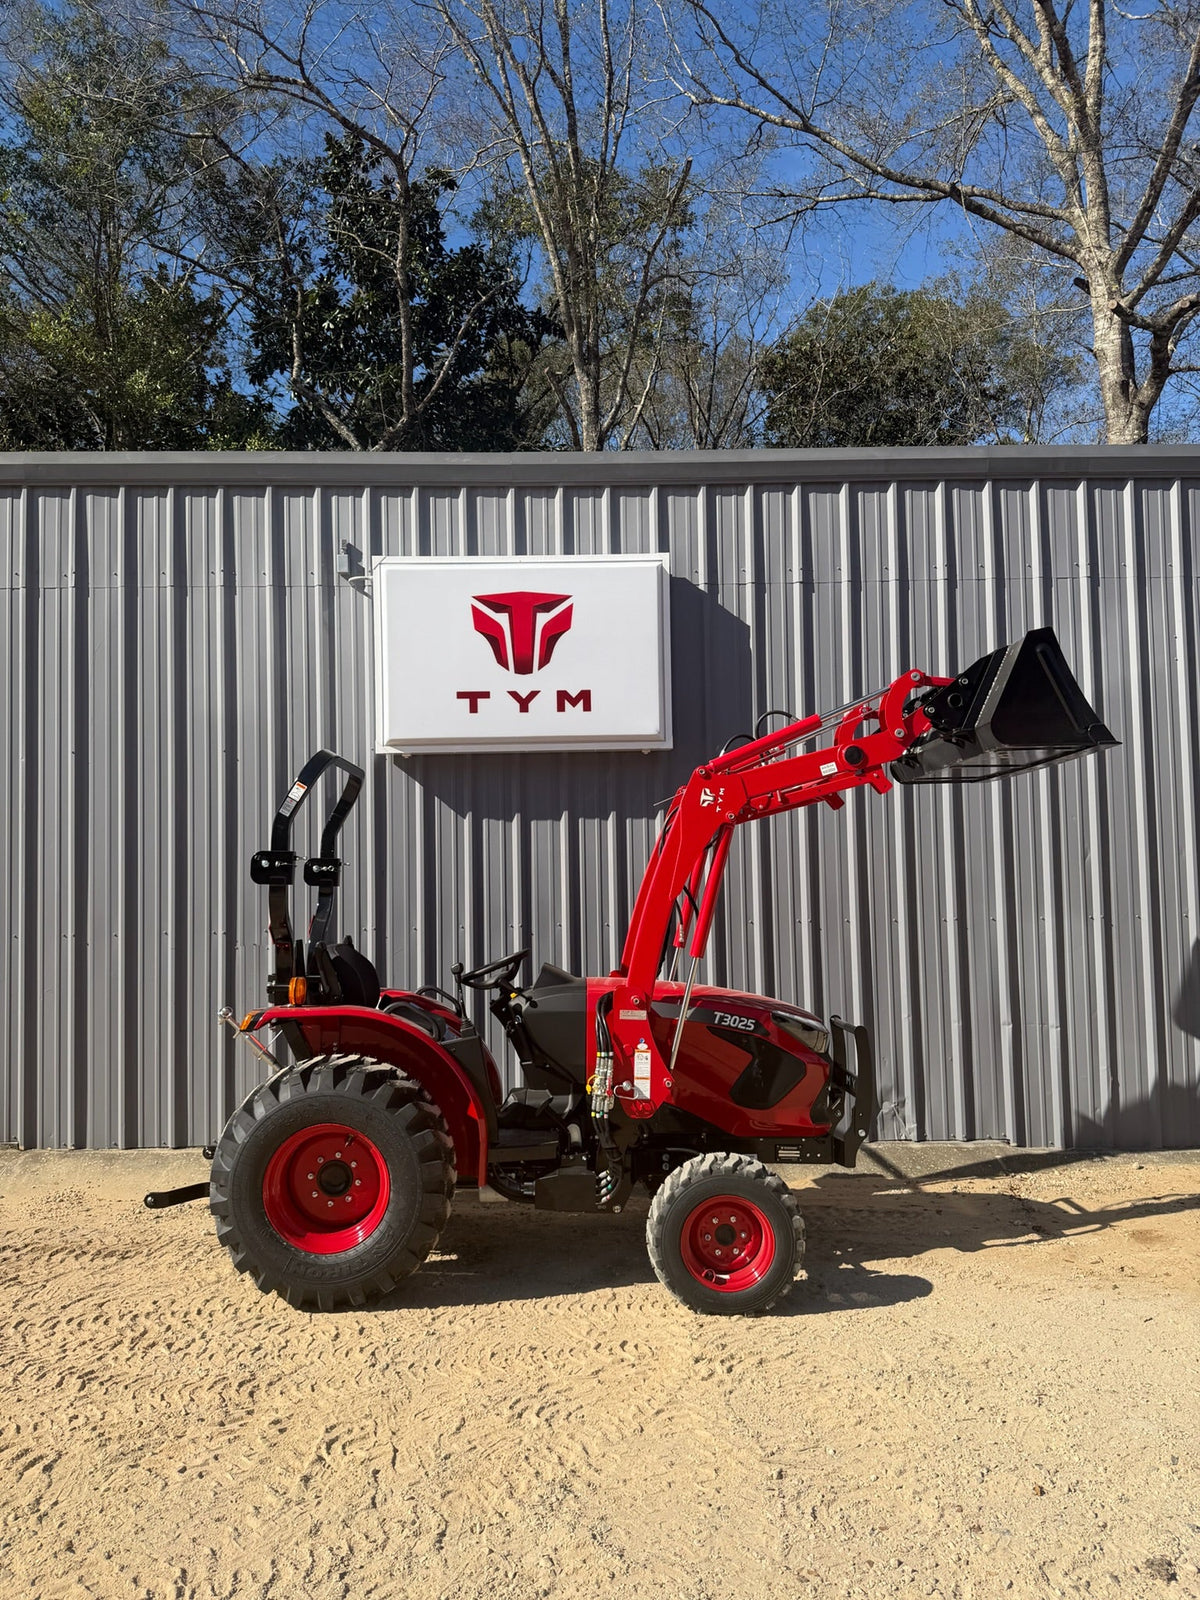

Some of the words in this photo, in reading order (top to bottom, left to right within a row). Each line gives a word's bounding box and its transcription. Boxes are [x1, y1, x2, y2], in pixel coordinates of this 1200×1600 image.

[456, 689, 592, 714] TYM
[716, 787, 725, 813] TYM
[713, 1011, 756, 1031] T3025
